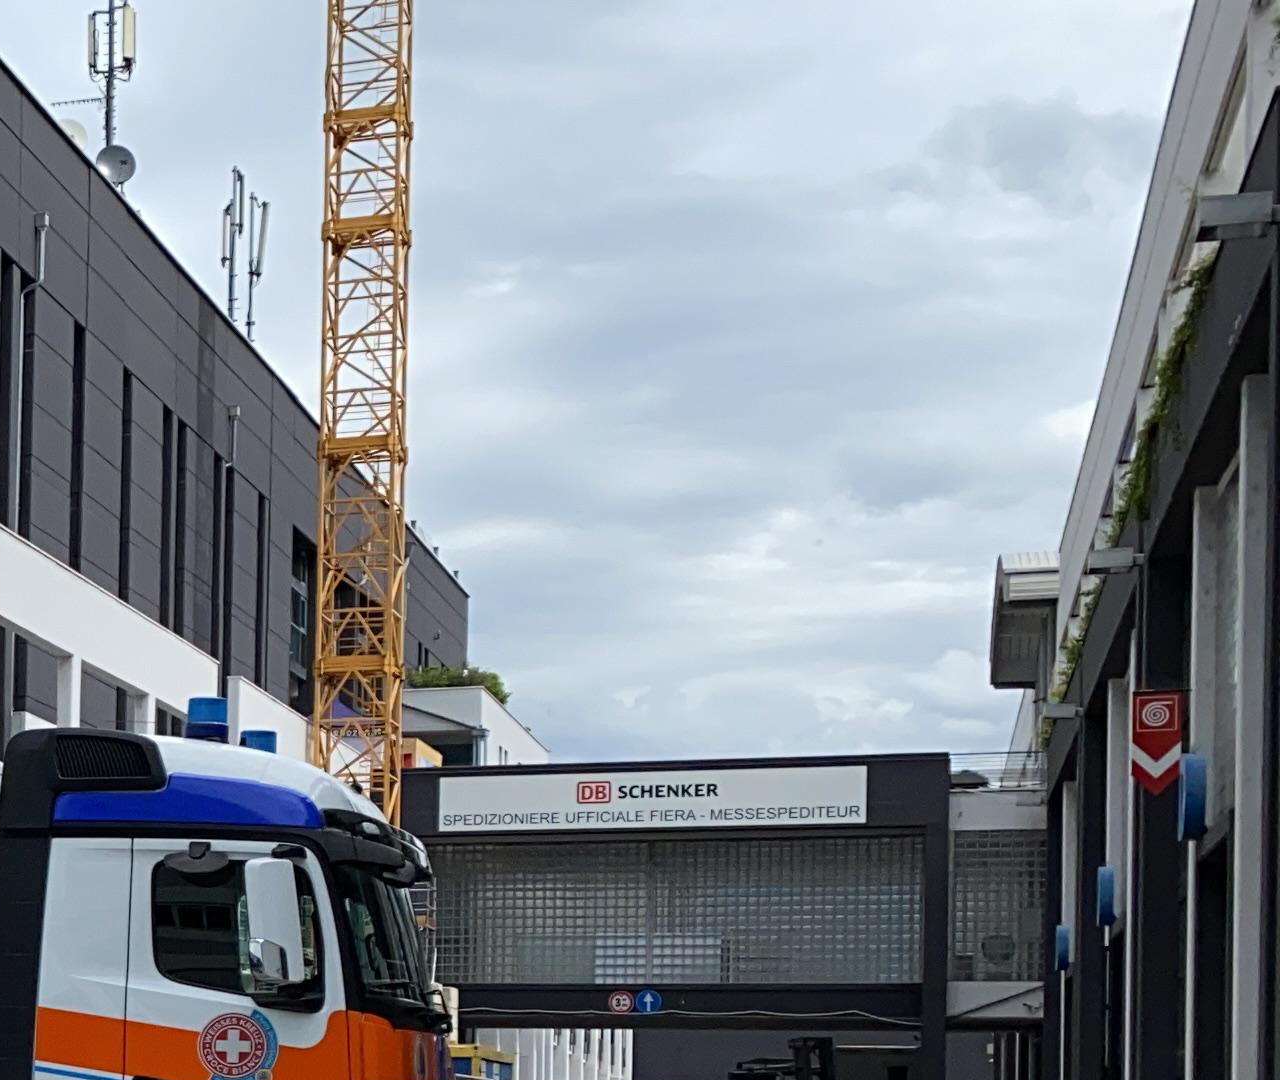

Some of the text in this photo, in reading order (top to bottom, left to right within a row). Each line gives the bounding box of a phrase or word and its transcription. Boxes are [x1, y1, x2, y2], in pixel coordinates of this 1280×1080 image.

[579, 783, 719, 802] DB SCHENKER
[443, 812, 560, 826] SPEDIZIONIERE
[565, 810, 645, 824] UFFICIALE
[650, 809, 697, 822] FIERA
[710, 805, 861, 821] MESSESPEDITEUR
[203, 1018, 237, 1043] WEISSES
[240, 1020, 263, 1044] KREUZ
[203, 1048, 263, 1075] CROCE BIANCA
